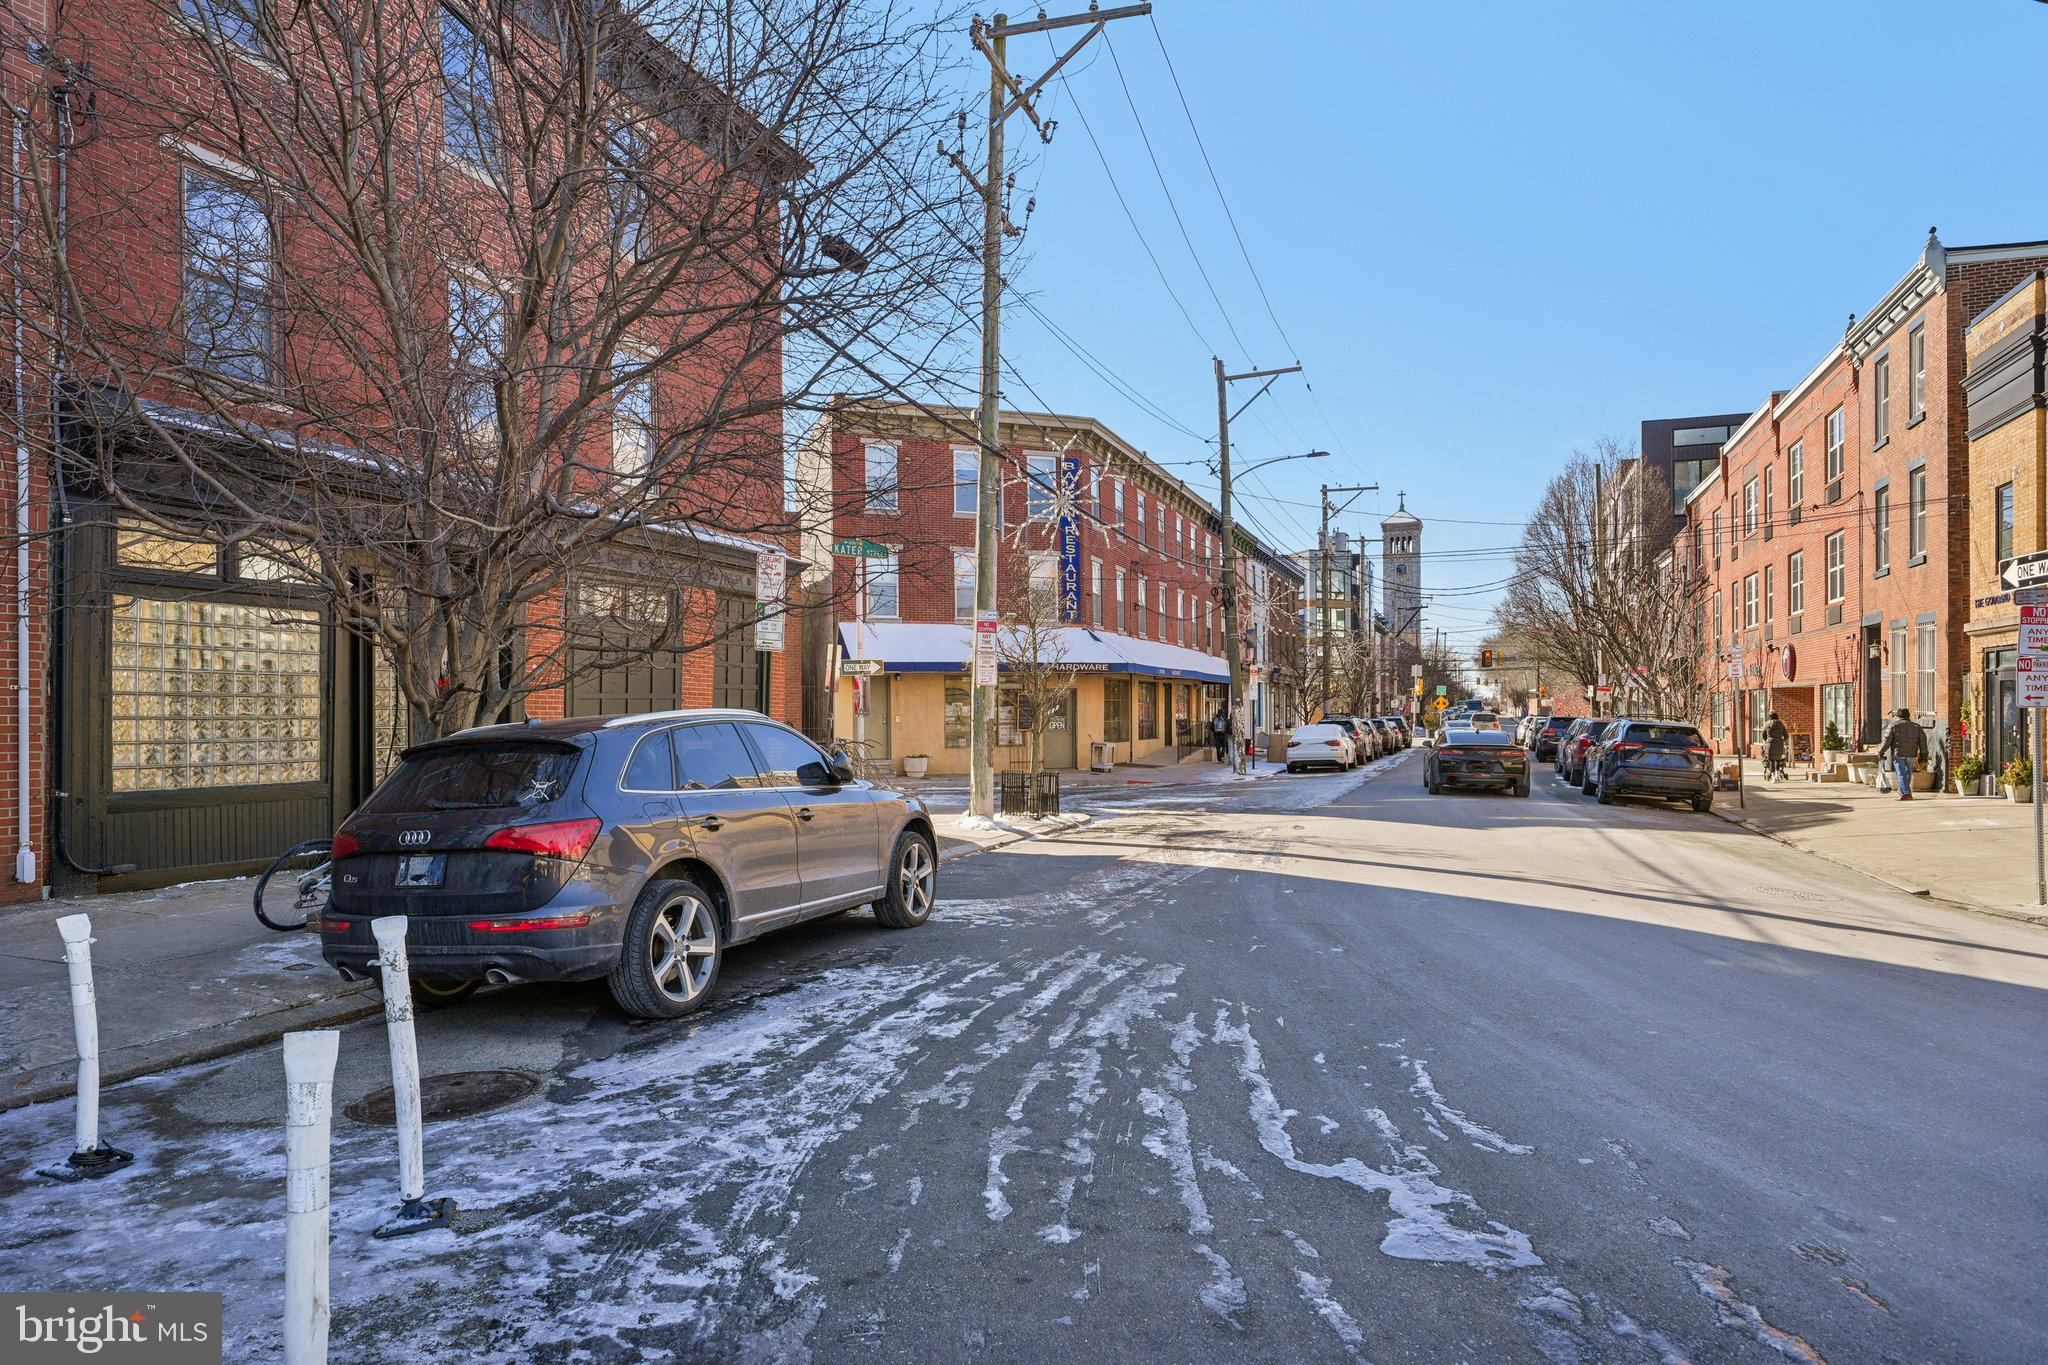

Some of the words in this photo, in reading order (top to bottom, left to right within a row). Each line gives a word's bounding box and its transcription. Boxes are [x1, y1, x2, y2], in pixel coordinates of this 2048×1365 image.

[834, 544, 862, 555] KATER
[1065, 526, 1077, 620] RESTAURANT
[2017, 564, 2035, 578] ONE
[2032, 607, 2046, 617] NO
[1053, 663, 1109, 671] HARDWARE
[2018, 660, 2031, 670] NO
[1049, 722, 1066, 730] OPEN
